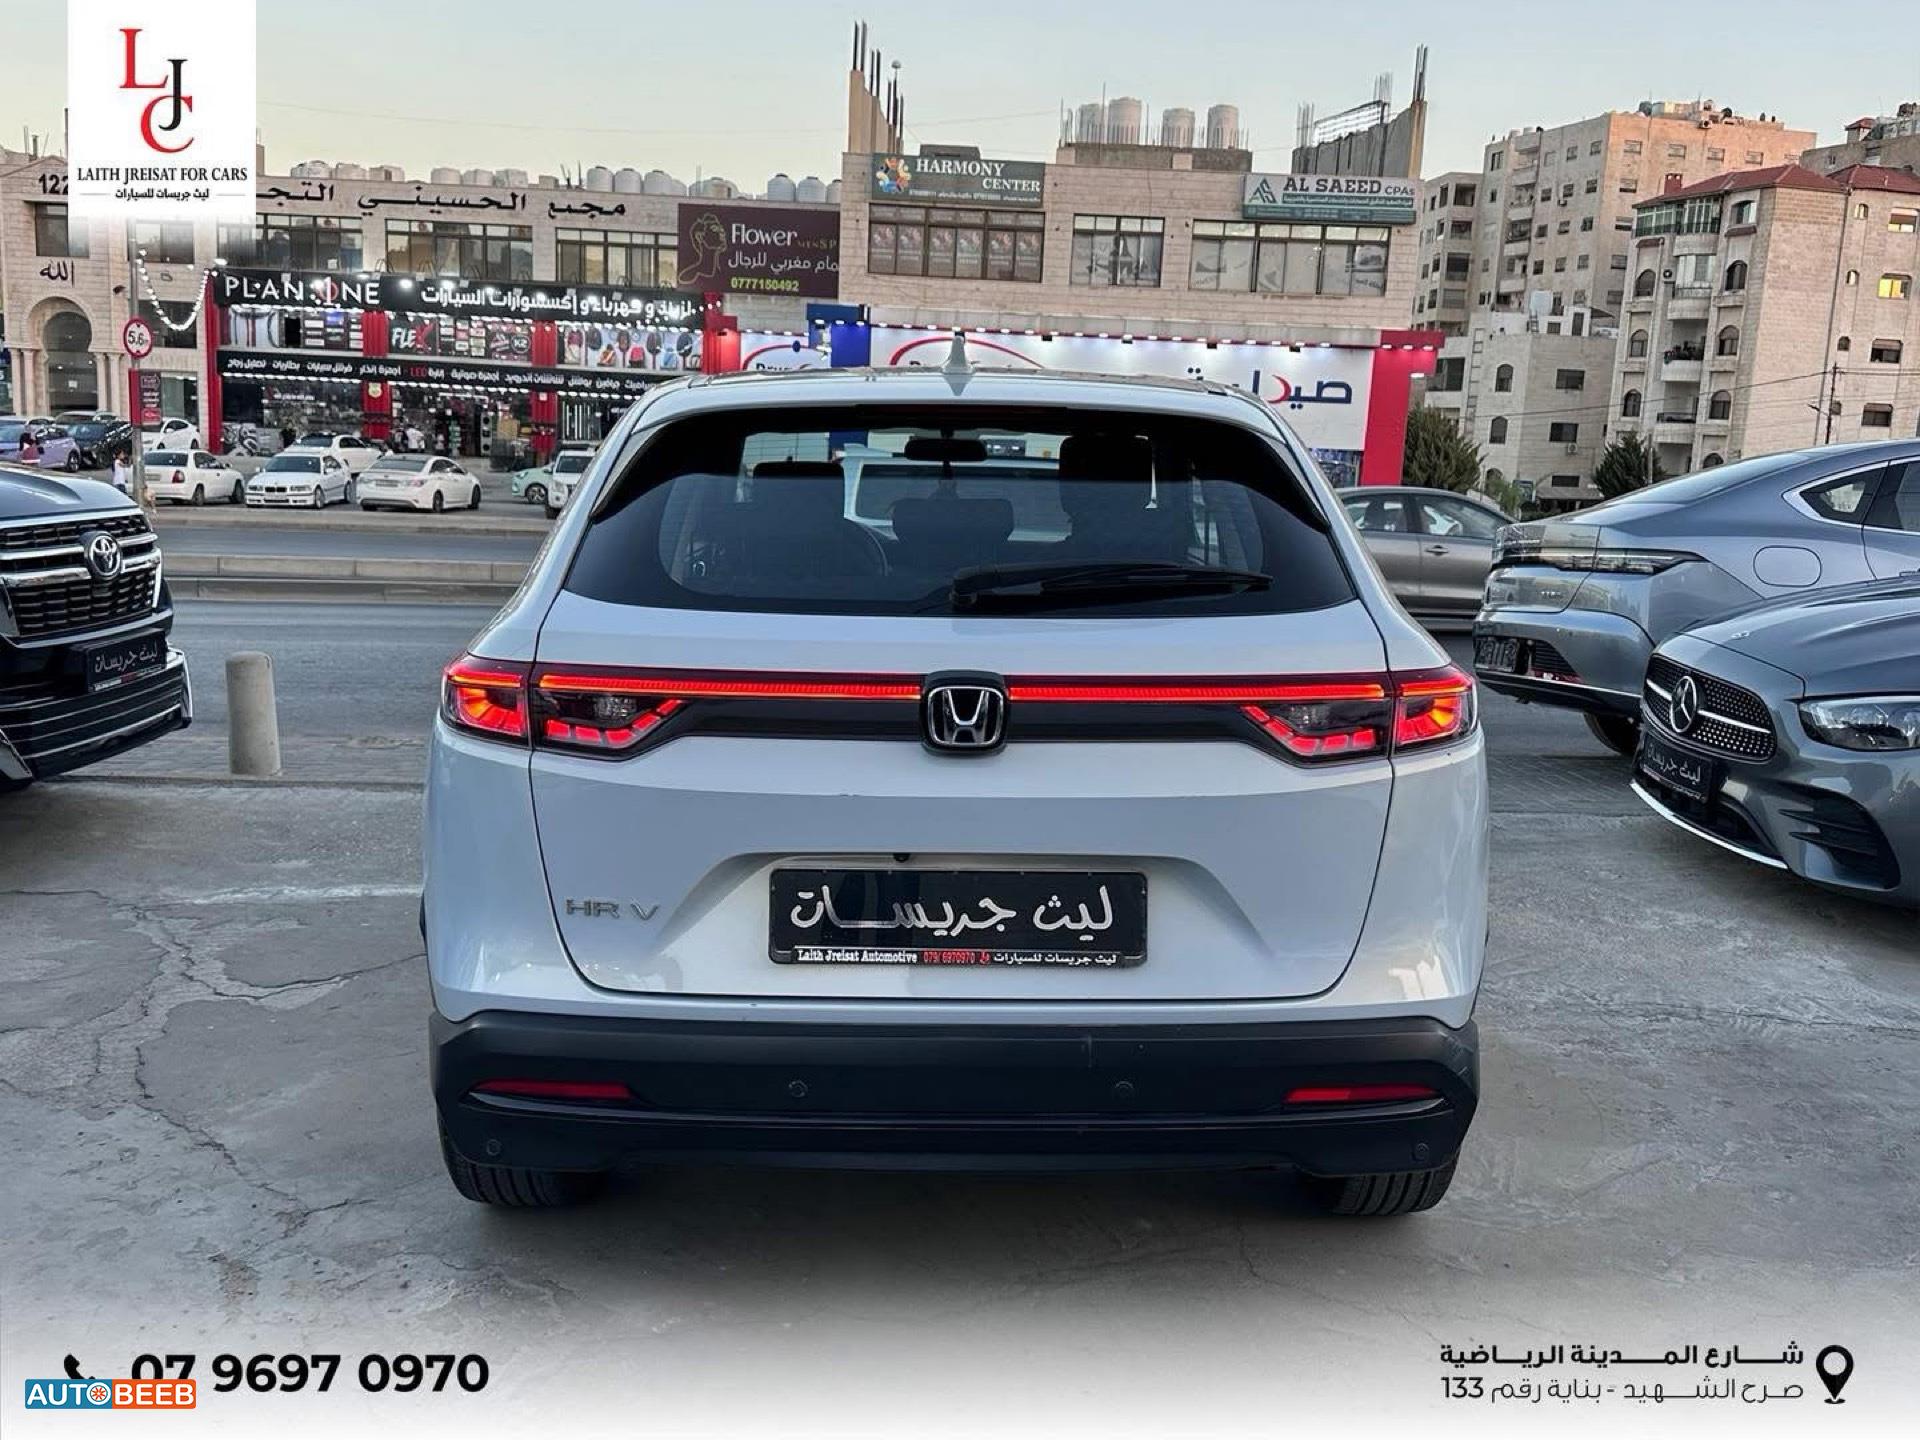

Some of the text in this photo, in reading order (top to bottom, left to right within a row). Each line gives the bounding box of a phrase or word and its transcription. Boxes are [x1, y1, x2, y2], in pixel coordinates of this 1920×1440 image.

[915, 158, 1006, 176] HARMONY
[982, 178, 1041, 192] CENTER
[1284, 176, 1309, 193] AL
[1316, 178, 1382, 195] SAEED
[357, 185, 527, 216] الحسيني
[548, 201, 626, 219] مجمع
[731, 223, 798, 247] Flower
[728, 251, 767, 269] للرجال
[770, 256, 811, 274] مغربي
[39, 260, 75, 287] الله
[225, 275, 303, 300] PLAN
[421, 285, 486, 307] السيارات
[590, 296, 642, 317] كهرباء
[790, 884, 1114, 941] ليث جريسات
[797, 949, 824, 961] Laith
[825, 950, 860, 962] Jreisat
[861, 951, 918, 964] Automotive
[994, 951, 1117, 966] ليث جريسات للسيارات
